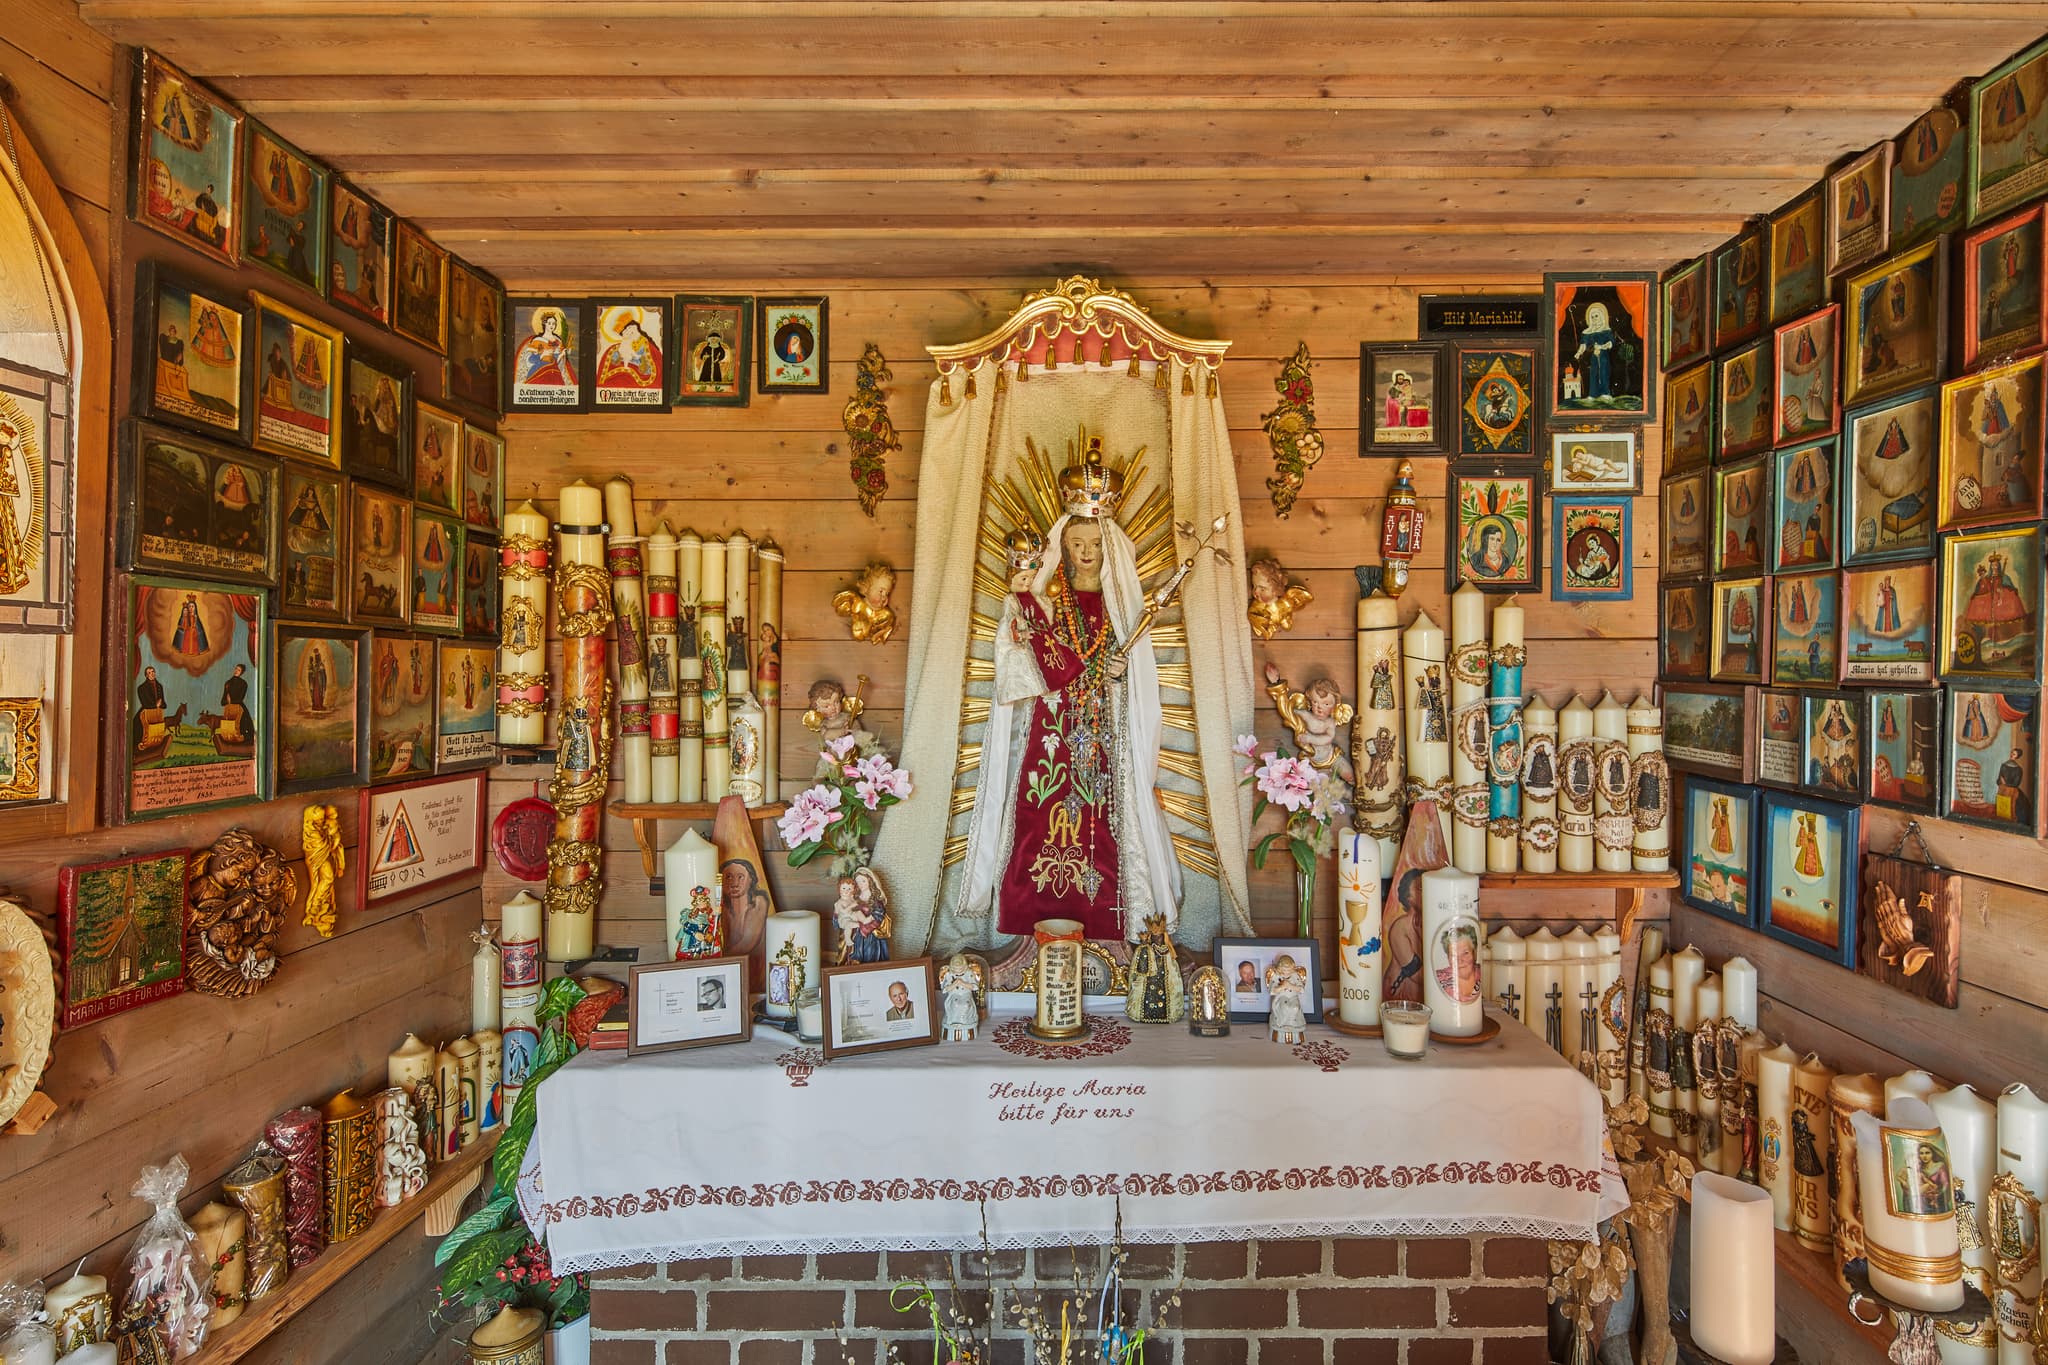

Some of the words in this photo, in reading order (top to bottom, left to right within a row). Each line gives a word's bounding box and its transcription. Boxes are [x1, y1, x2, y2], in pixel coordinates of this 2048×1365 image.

[1443, 311, 1465, 325] Hilf
[1385, 515, 1396, 545] AVE
[1413, 512, 1424, 549] MARIA
[1850, 665, 1875, 676] Maria
[1877, 664, 1888, 676] hat
[446, 736, 460, 746] Gott
[1343, 987, 1370, 1000] 2006
[988, 1081, 1066, 1104] Heilige
[1073, 1079, 1147, 1096] Maria
[998, 1104, 1045, 1121] bitte
[1049, 1102, 1088, 1125] für
[1093, 1106, 1135, 1118] uns
